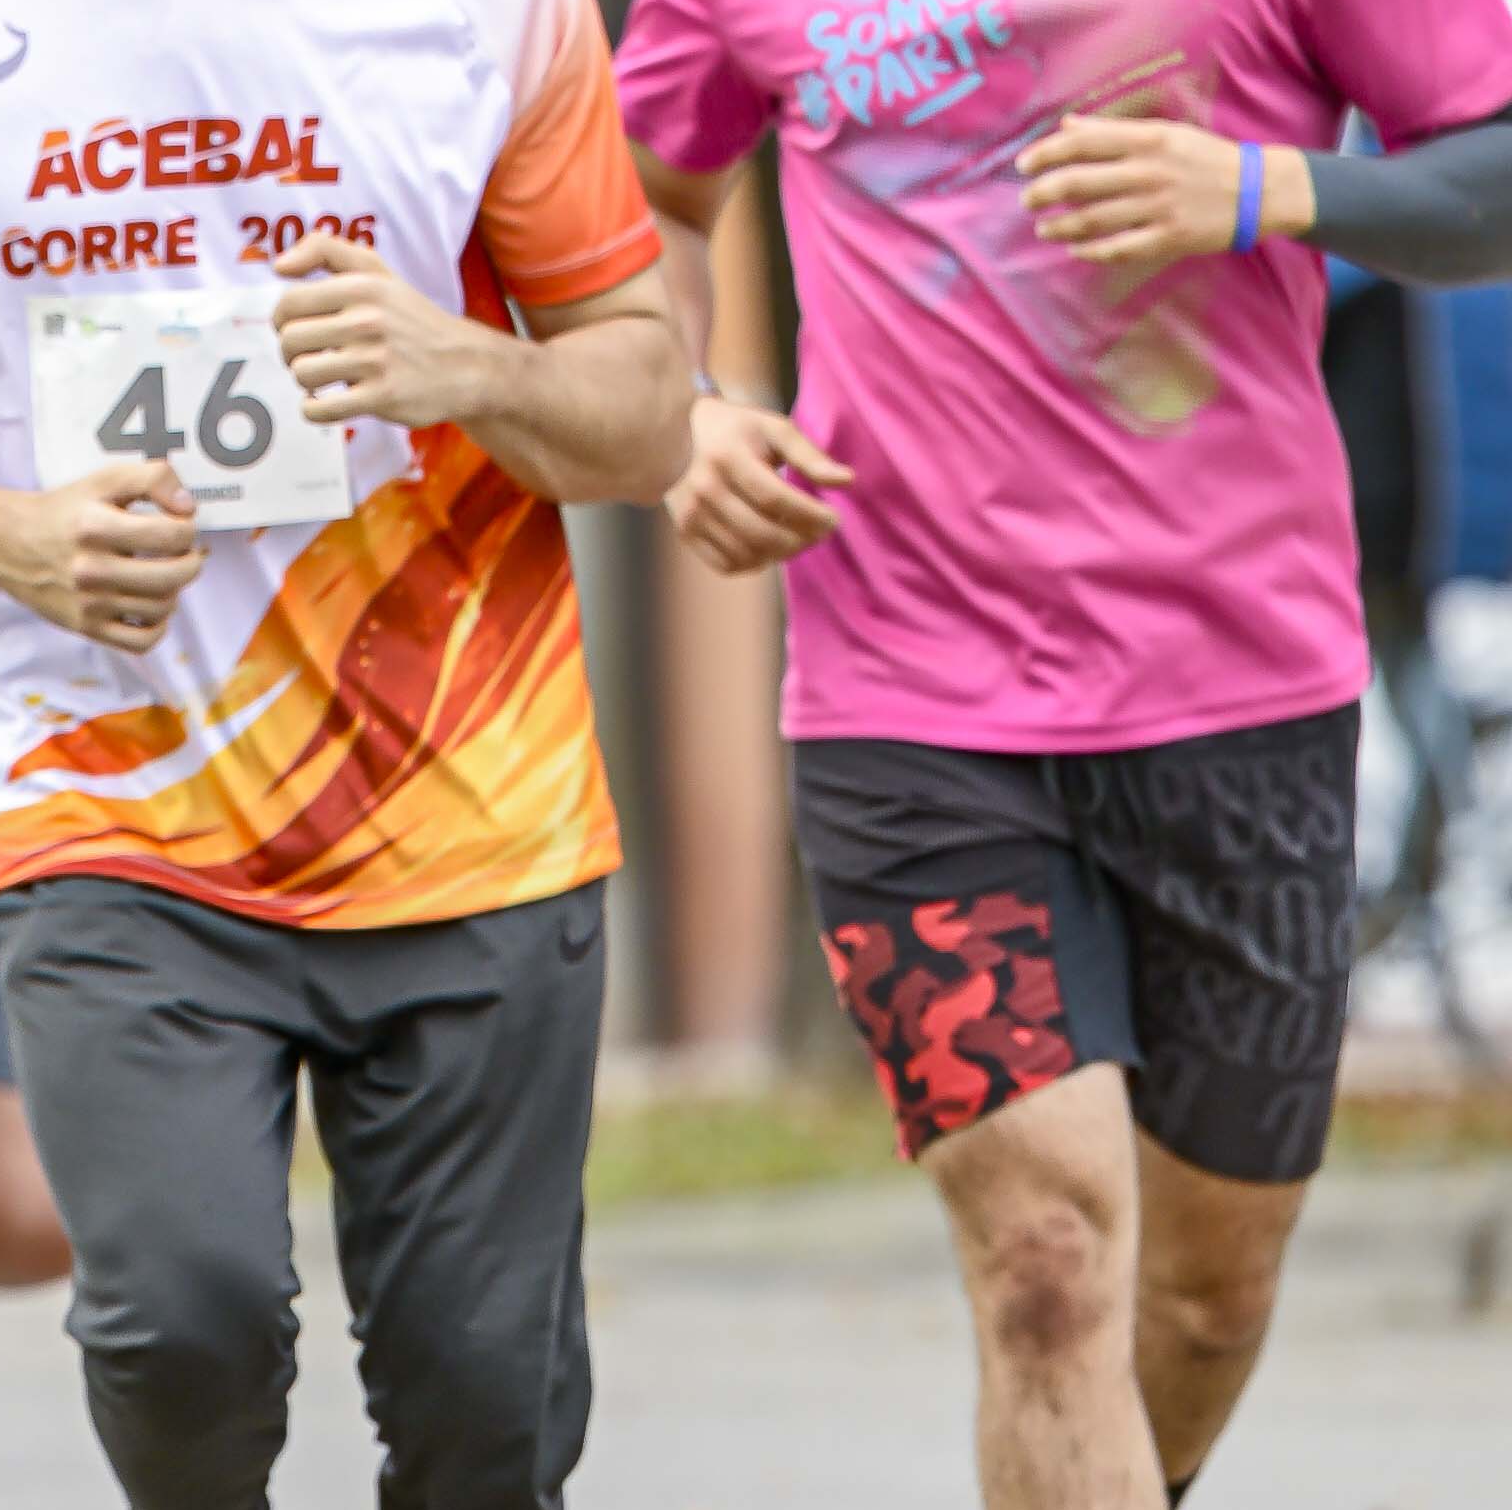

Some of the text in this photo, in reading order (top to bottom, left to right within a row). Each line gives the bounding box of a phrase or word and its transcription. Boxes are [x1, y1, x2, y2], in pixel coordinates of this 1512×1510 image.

[28, 117, 339, 201] ACEBAL
[0, 216, 197, 278] CORRE
[97, 359, 273, 467] 46
